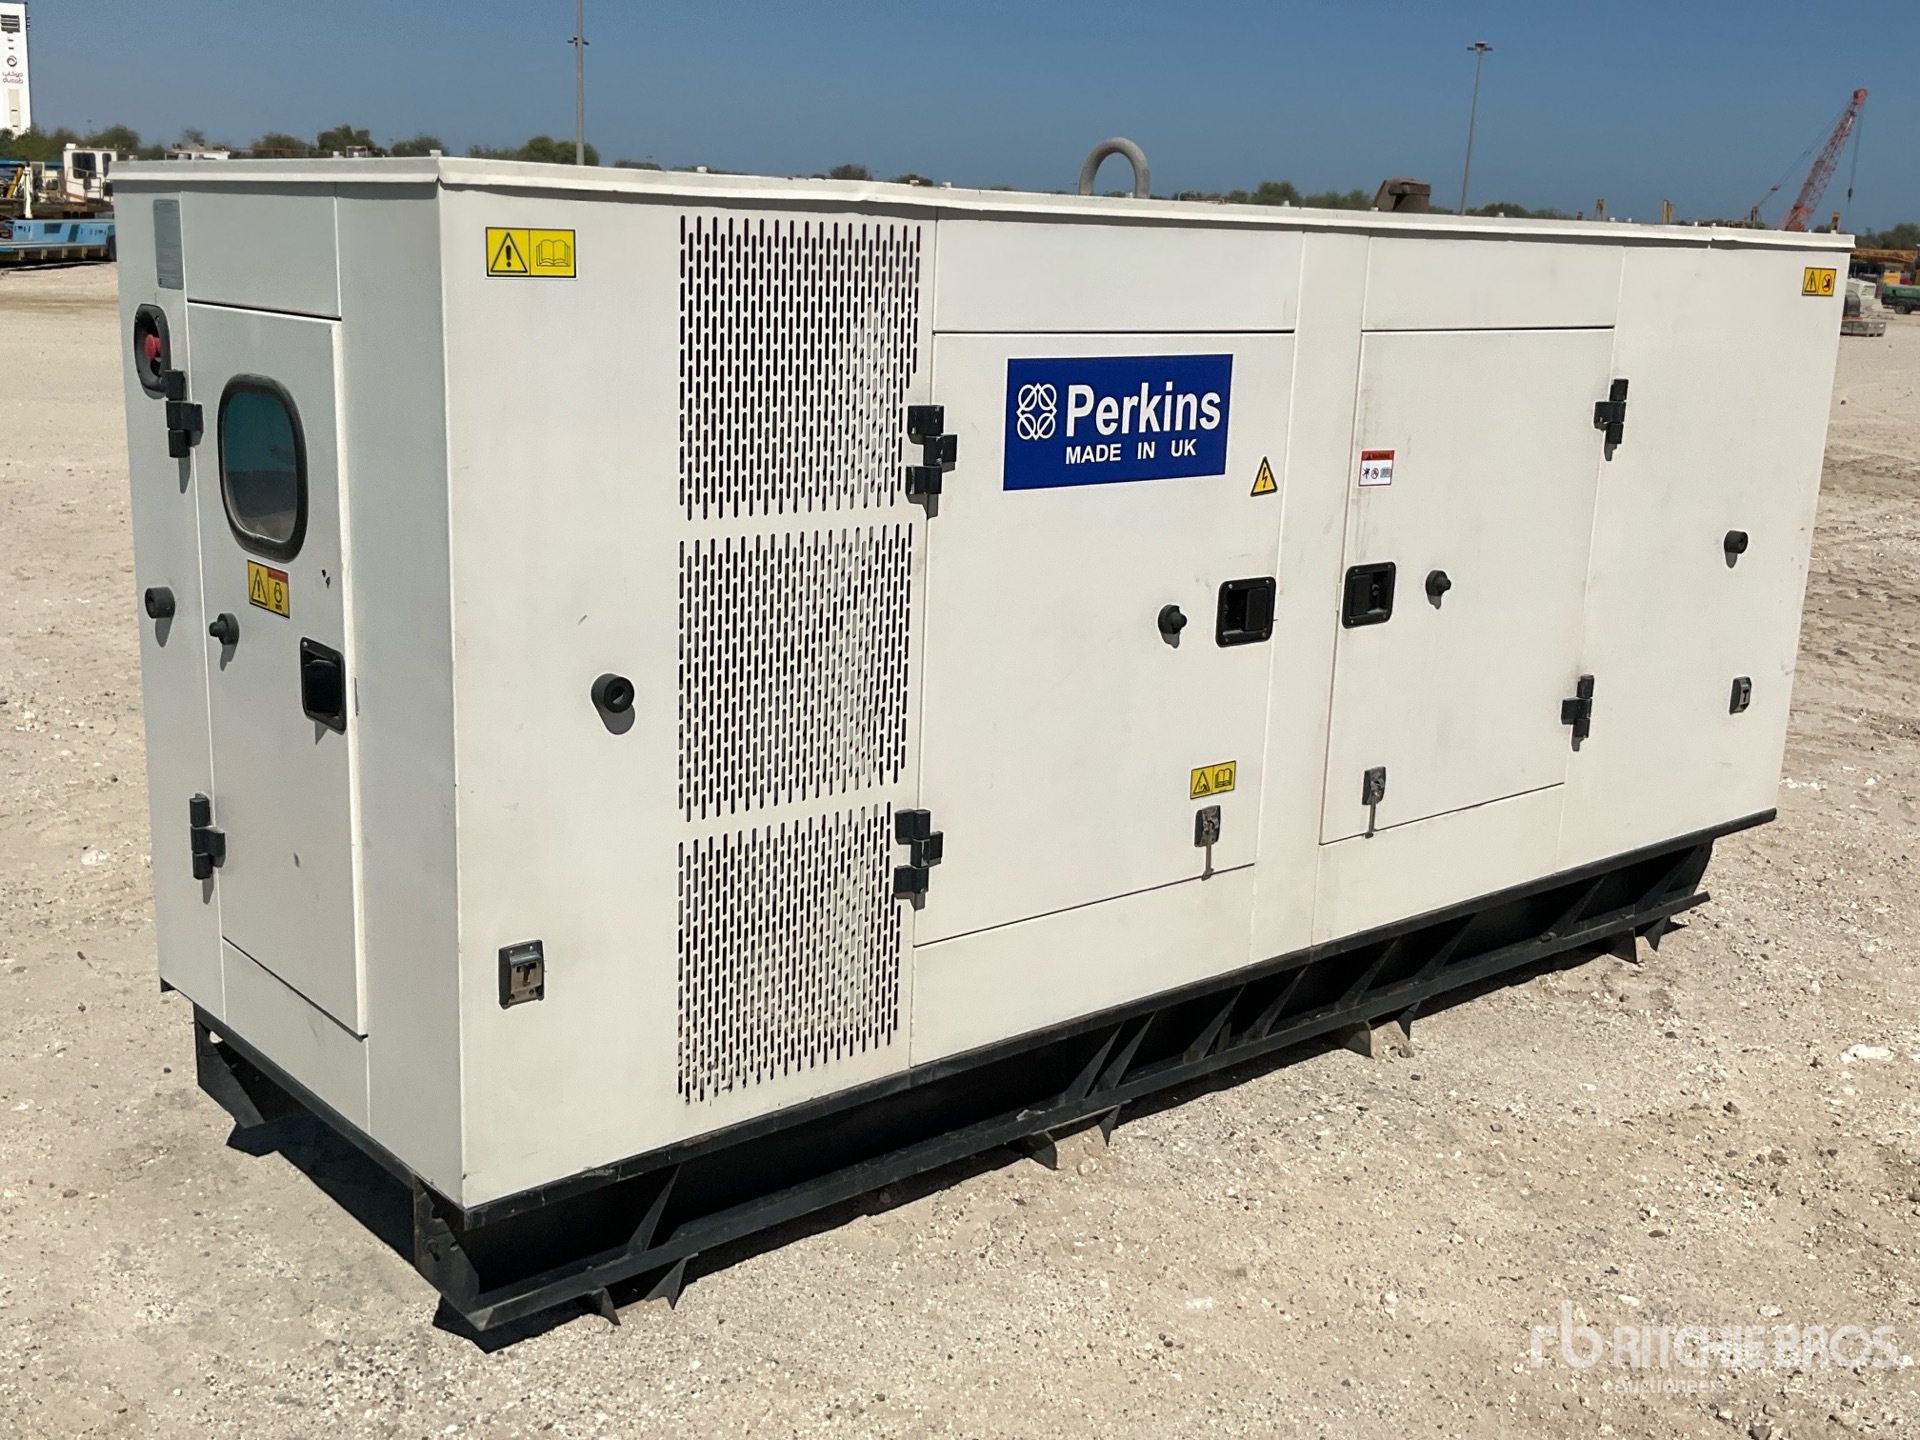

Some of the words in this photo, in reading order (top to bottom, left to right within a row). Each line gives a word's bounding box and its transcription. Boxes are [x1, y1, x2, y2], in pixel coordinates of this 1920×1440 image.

[1066, 381, 1221, 437] Perkins
[1065, 443, 1122, 465] MADE
[1137, 441, 1156, 460] IN
[1171, 439, 1197, 458] UK
